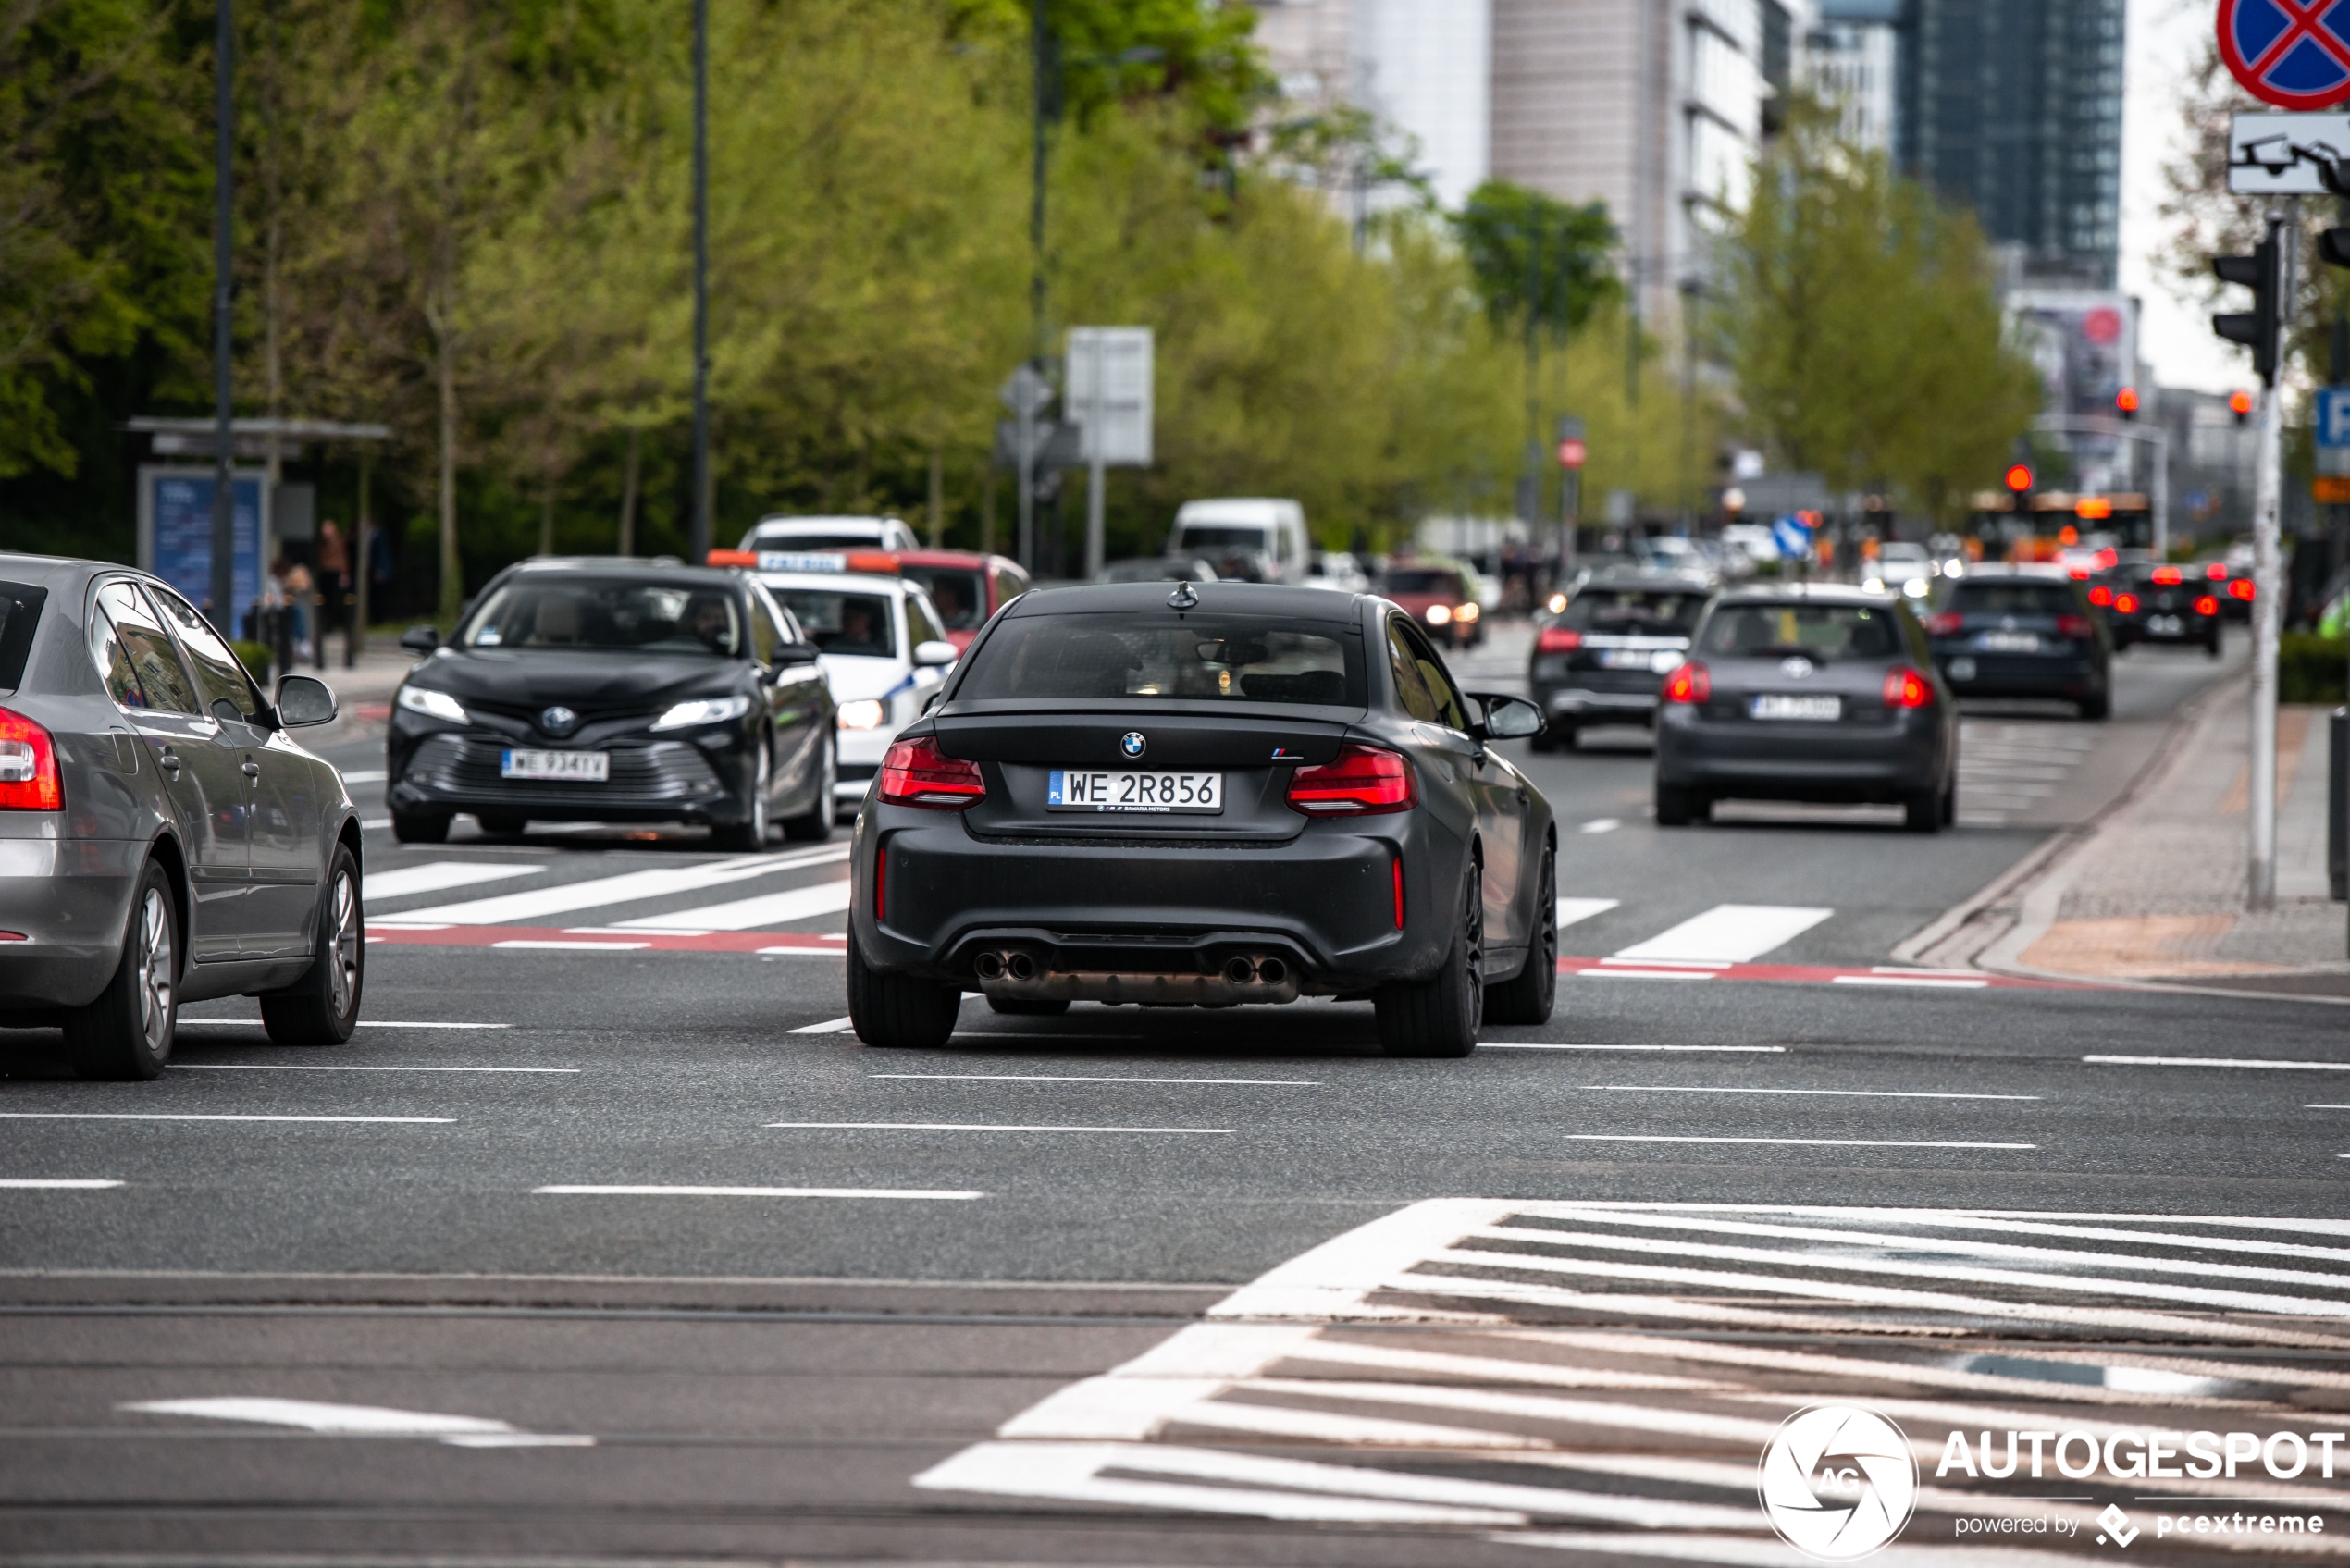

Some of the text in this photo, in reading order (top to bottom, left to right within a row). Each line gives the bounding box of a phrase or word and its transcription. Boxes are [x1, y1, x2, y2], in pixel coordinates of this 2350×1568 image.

[1050, 791, 1061, 800] PL
[1070, 773, 1214, 804] WE 2R856
